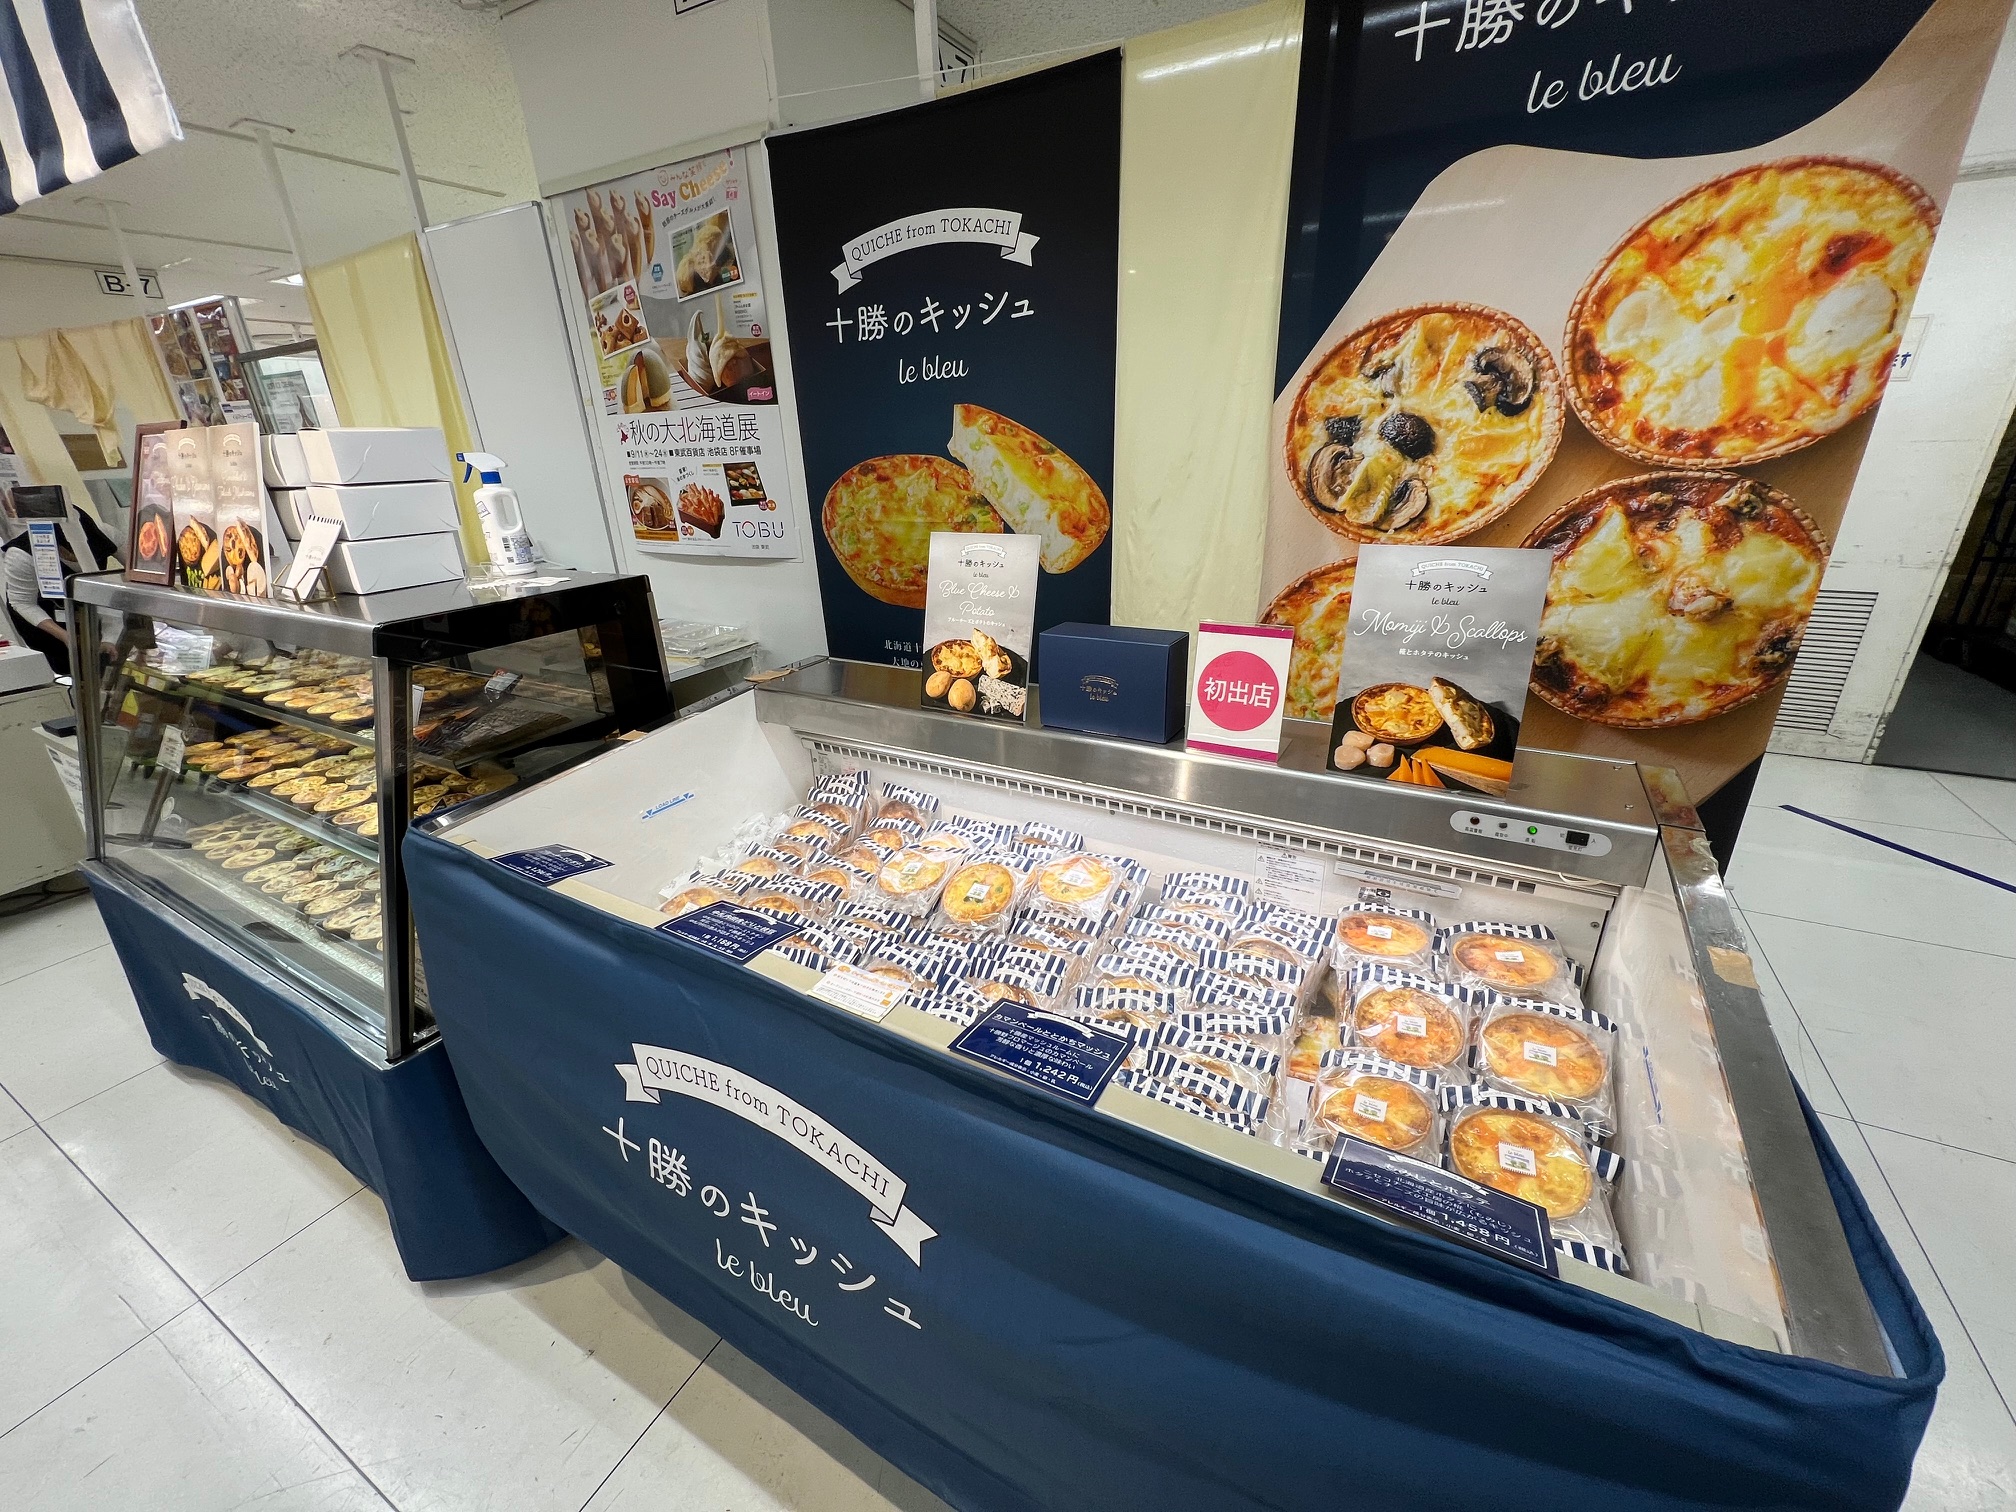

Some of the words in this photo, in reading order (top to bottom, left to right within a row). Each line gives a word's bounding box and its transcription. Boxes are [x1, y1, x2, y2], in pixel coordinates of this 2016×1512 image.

[1527, 70, 1569, 114] le
[1578, 53, 1683, 101] bleu
[651, 189, 676, 209] Say
[851, 227, 903, 262] QUICHE
[906, 220, 936, 238] from
[940, 218, 1012, 237] TOKACHI
[103, 274, 150, 295] B-7
[826, 291, 1035, 344] 十勝のキッシュ
[898, 361, 918, 385] le
[921, 356, 969, 381] bleu
[630, 413, 761, 446] 秋の大北海道展
[732, 521, 784, 538] TOBU
[958, 559, 1004, 568] 十勝のキッシュ
[939, 580, 966, 598] Blue
[967, 582, 1006, 600] Cheese
[1405, 579, 1488, 593] 十勝のキッシュ
[1431, 597, 1440, 605] le
[1441, 597, 1460, 606] bleu
[959, 600, 995, 617] Potato
[1353, 608, 1427, 644] Momiji
[1446, 615, 1528, 650] Scallops
[893, 656, 923, 667] 大地の
[1203, 676, 1275, 709] 初出店
[992, 1013, 1113, 1058] カマンベールととかちマッシュ
[646, 1056, 720, 1092] QUICHE
[725, 1079, 770, 1116] from
[777, 1105, 891, 1198] TOKACHI
[602, 1117, 922, 1330] 十勝のキッシュ
[716, 1238, 744, 1277] le
[750, 1261, 819, 1326] bleu
